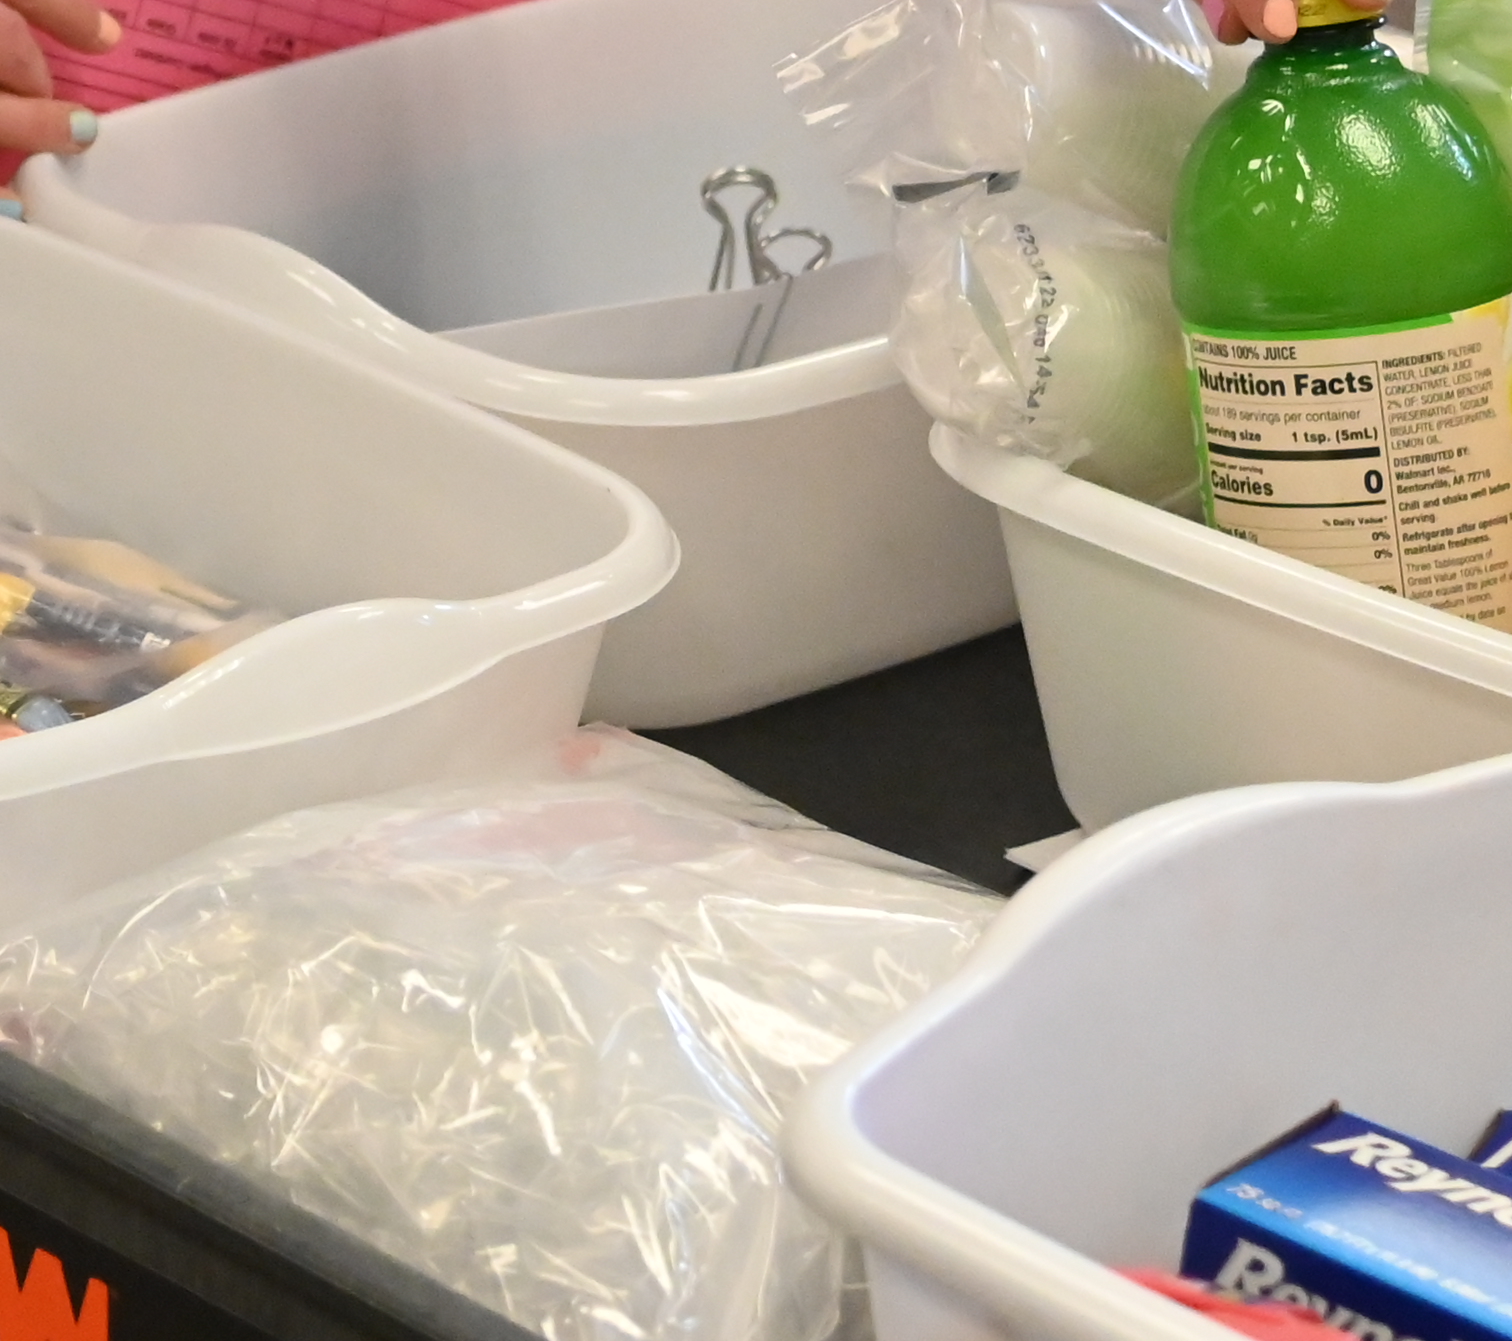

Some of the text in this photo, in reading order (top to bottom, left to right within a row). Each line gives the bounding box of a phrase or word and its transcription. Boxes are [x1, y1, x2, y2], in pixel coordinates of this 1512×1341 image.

[1231, 345, 1260, 360] 100%
[1263, 346, 1297, 361] JUICE
[1418, 364, 1450, 378] LEMON
[1451, 358, 1473, 372] JUICE
[1198, 365, 1374, 397] Nutrition Facts
[1420, 389, 1455, 405] SODIUM
[1239, 409, 1281, 426] servings
[1284, 411, 1302, 426] per
[1305, 409, 1361, 423] container
[1205, 422, 1378, 445] Serving size 1 tsp. (5mL)
[1391, 437, 1424, 451] LEMON
[1393, 449, 1454, 468] DISTRIBUTED
[1211, 468, 1384, 497] Calories 0
[1395, 468, 1435, 481] Walmart
[1398, 499, 1420, 512] Chill
[1423, 497, 1440, 508] and
[1442, 492, 1469, 505] shake
[1371, 530, 1391, 542] 0%
[1402, 527, 1455, 542] Refrigerate
[1456, 522, 1476, 534] after
[1478, 514, 1508, 530] opening
[1374, 548, 1393, 560] 0%
[1404, 543, 1446, 556] maintain
[1406, 562, 1432, 573] Three
[1407, 575, 1433, 588] Great
[1434, 571, 1457, 584] Value
